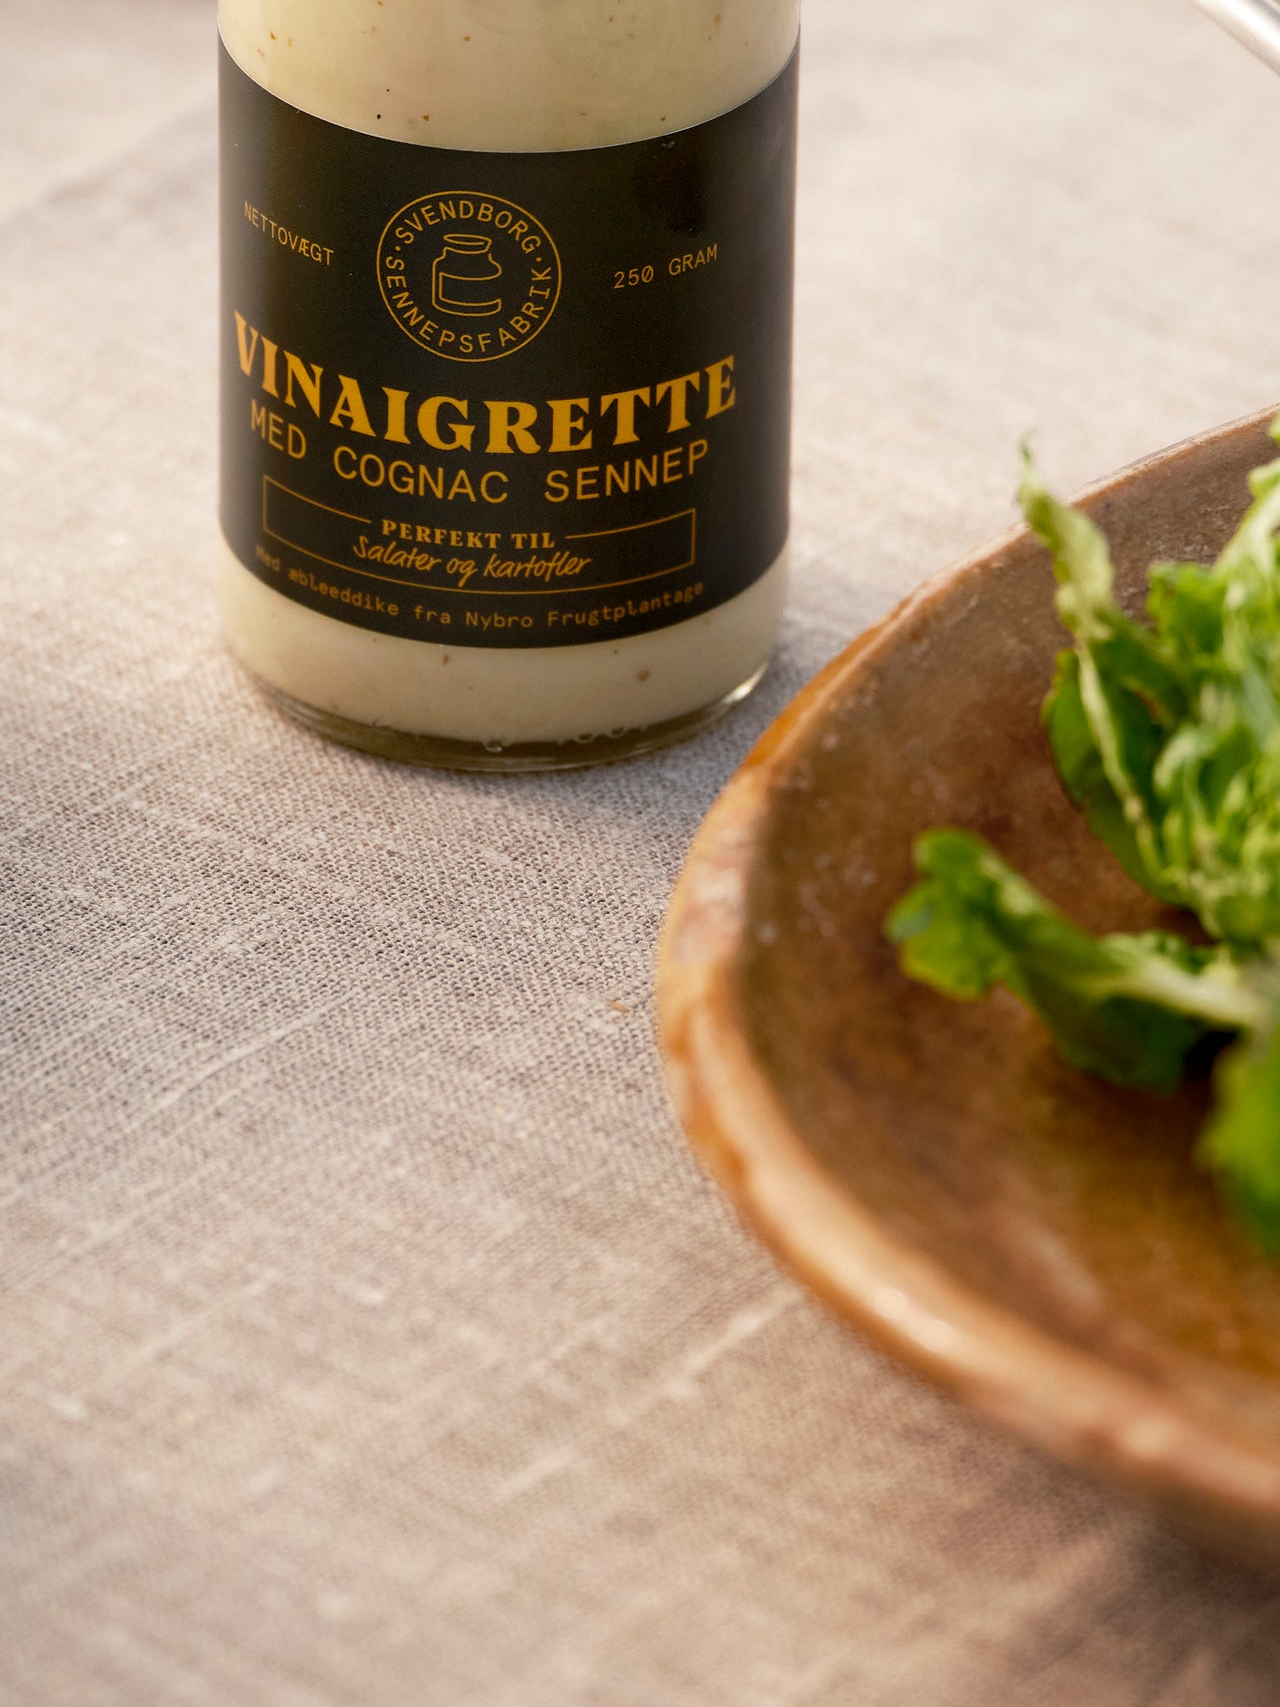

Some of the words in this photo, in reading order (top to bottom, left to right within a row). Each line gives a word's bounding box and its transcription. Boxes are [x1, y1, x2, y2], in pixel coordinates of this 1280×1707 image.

[244, 200, 334, 266] NETTOVÆGT
[395, 199, 540, 255] SVENDBORG
[613, 266, 655, 290] 250
[668, 242, 719, 279] GRAM
[385, 256, 553, 353] SENNEPSFABRIK
[233, 310, 737, 454] VINAIGRETTE
[250, 399, 307, 460] MED
[333, 446, 509, 505] COGNAC
[544, 439, 710, 503] SENNEP
[352, 535, 442, 572] Salater
[446, 556, 478, 588] og
[483, 550, 592, 583] kartofler
[381, 518, 501, 549] PERFEKT
[511, 531, 556, 549] TIL
[288, 566, 399, 616] æbleeddike
[414, 604, 452, 625] fra
[465, 611, 534, 632] Nybro
[546, 581, 704, 628] Frugtplantage
